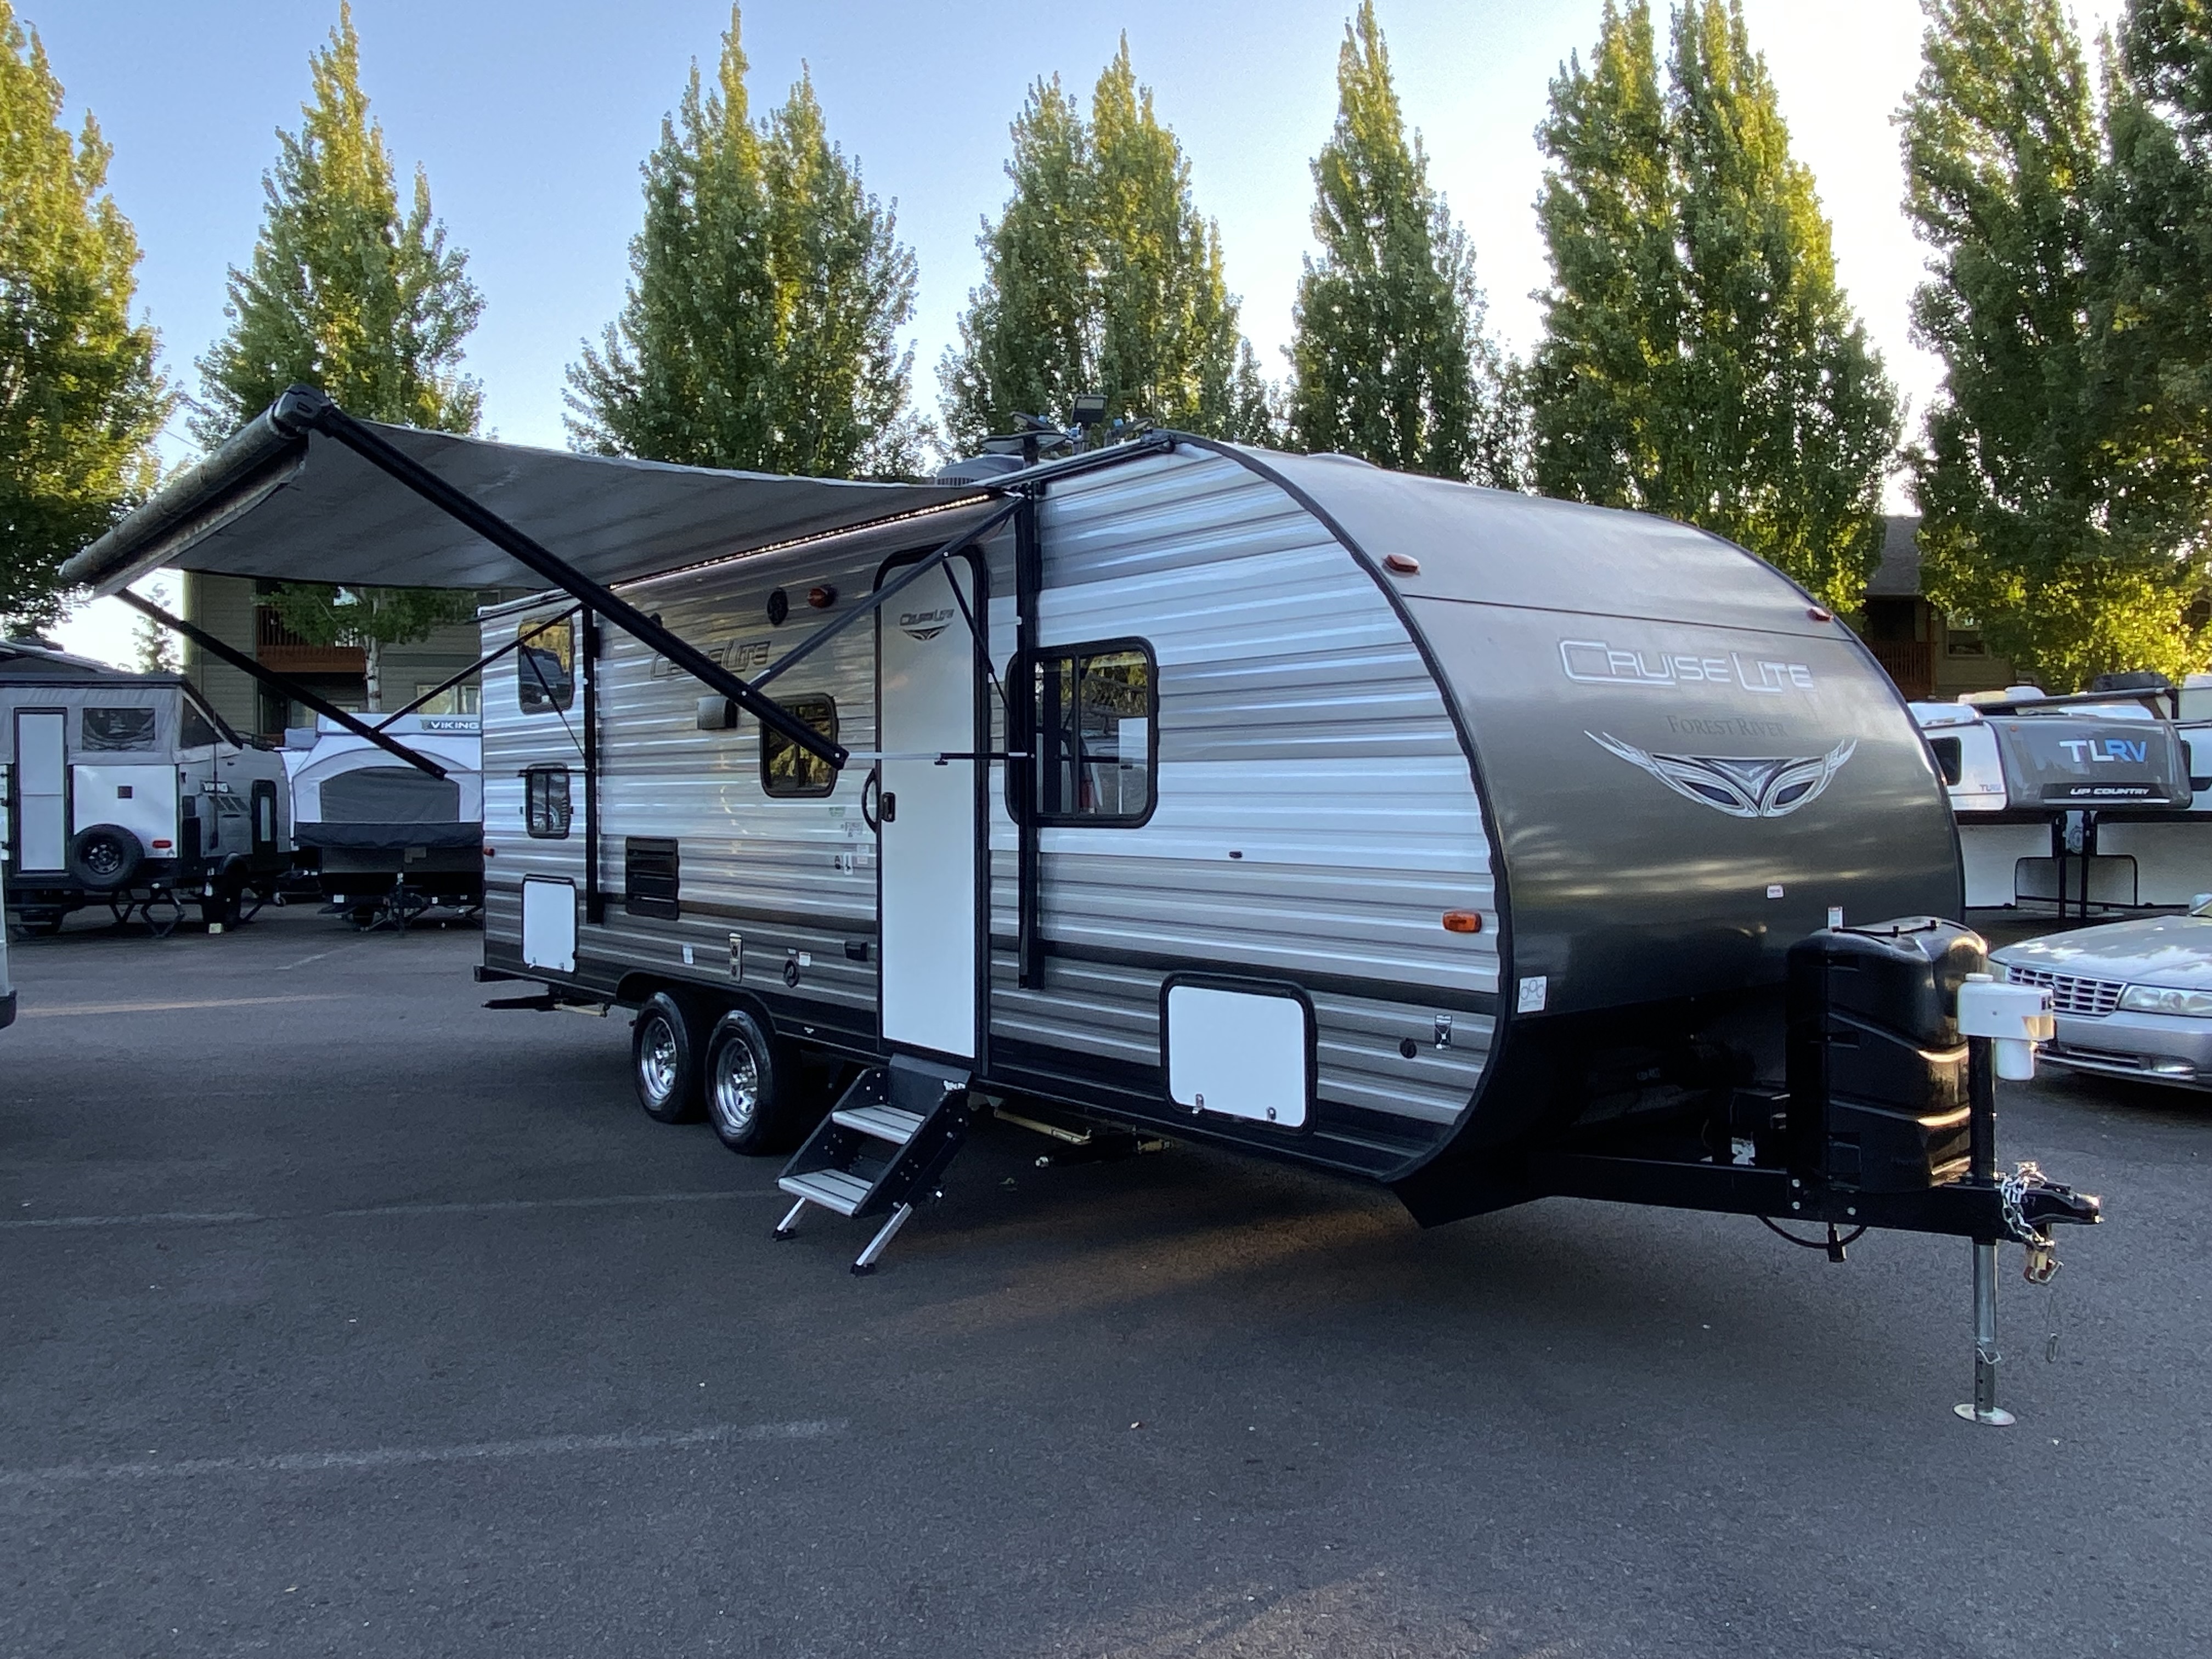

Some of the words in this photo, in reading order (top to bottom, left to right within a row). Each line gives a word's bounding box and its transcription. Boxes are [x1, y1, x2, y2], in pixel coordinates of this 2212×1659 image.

[431, 721, 479, 729] VIKING
[1667, 715, 1732, 736] FOREST
[1737, 716, 1788, 738] RIVER
[2059, 739, 2147, 763] TLRV
[2093, 787, 2150, 795] COUNTRY
